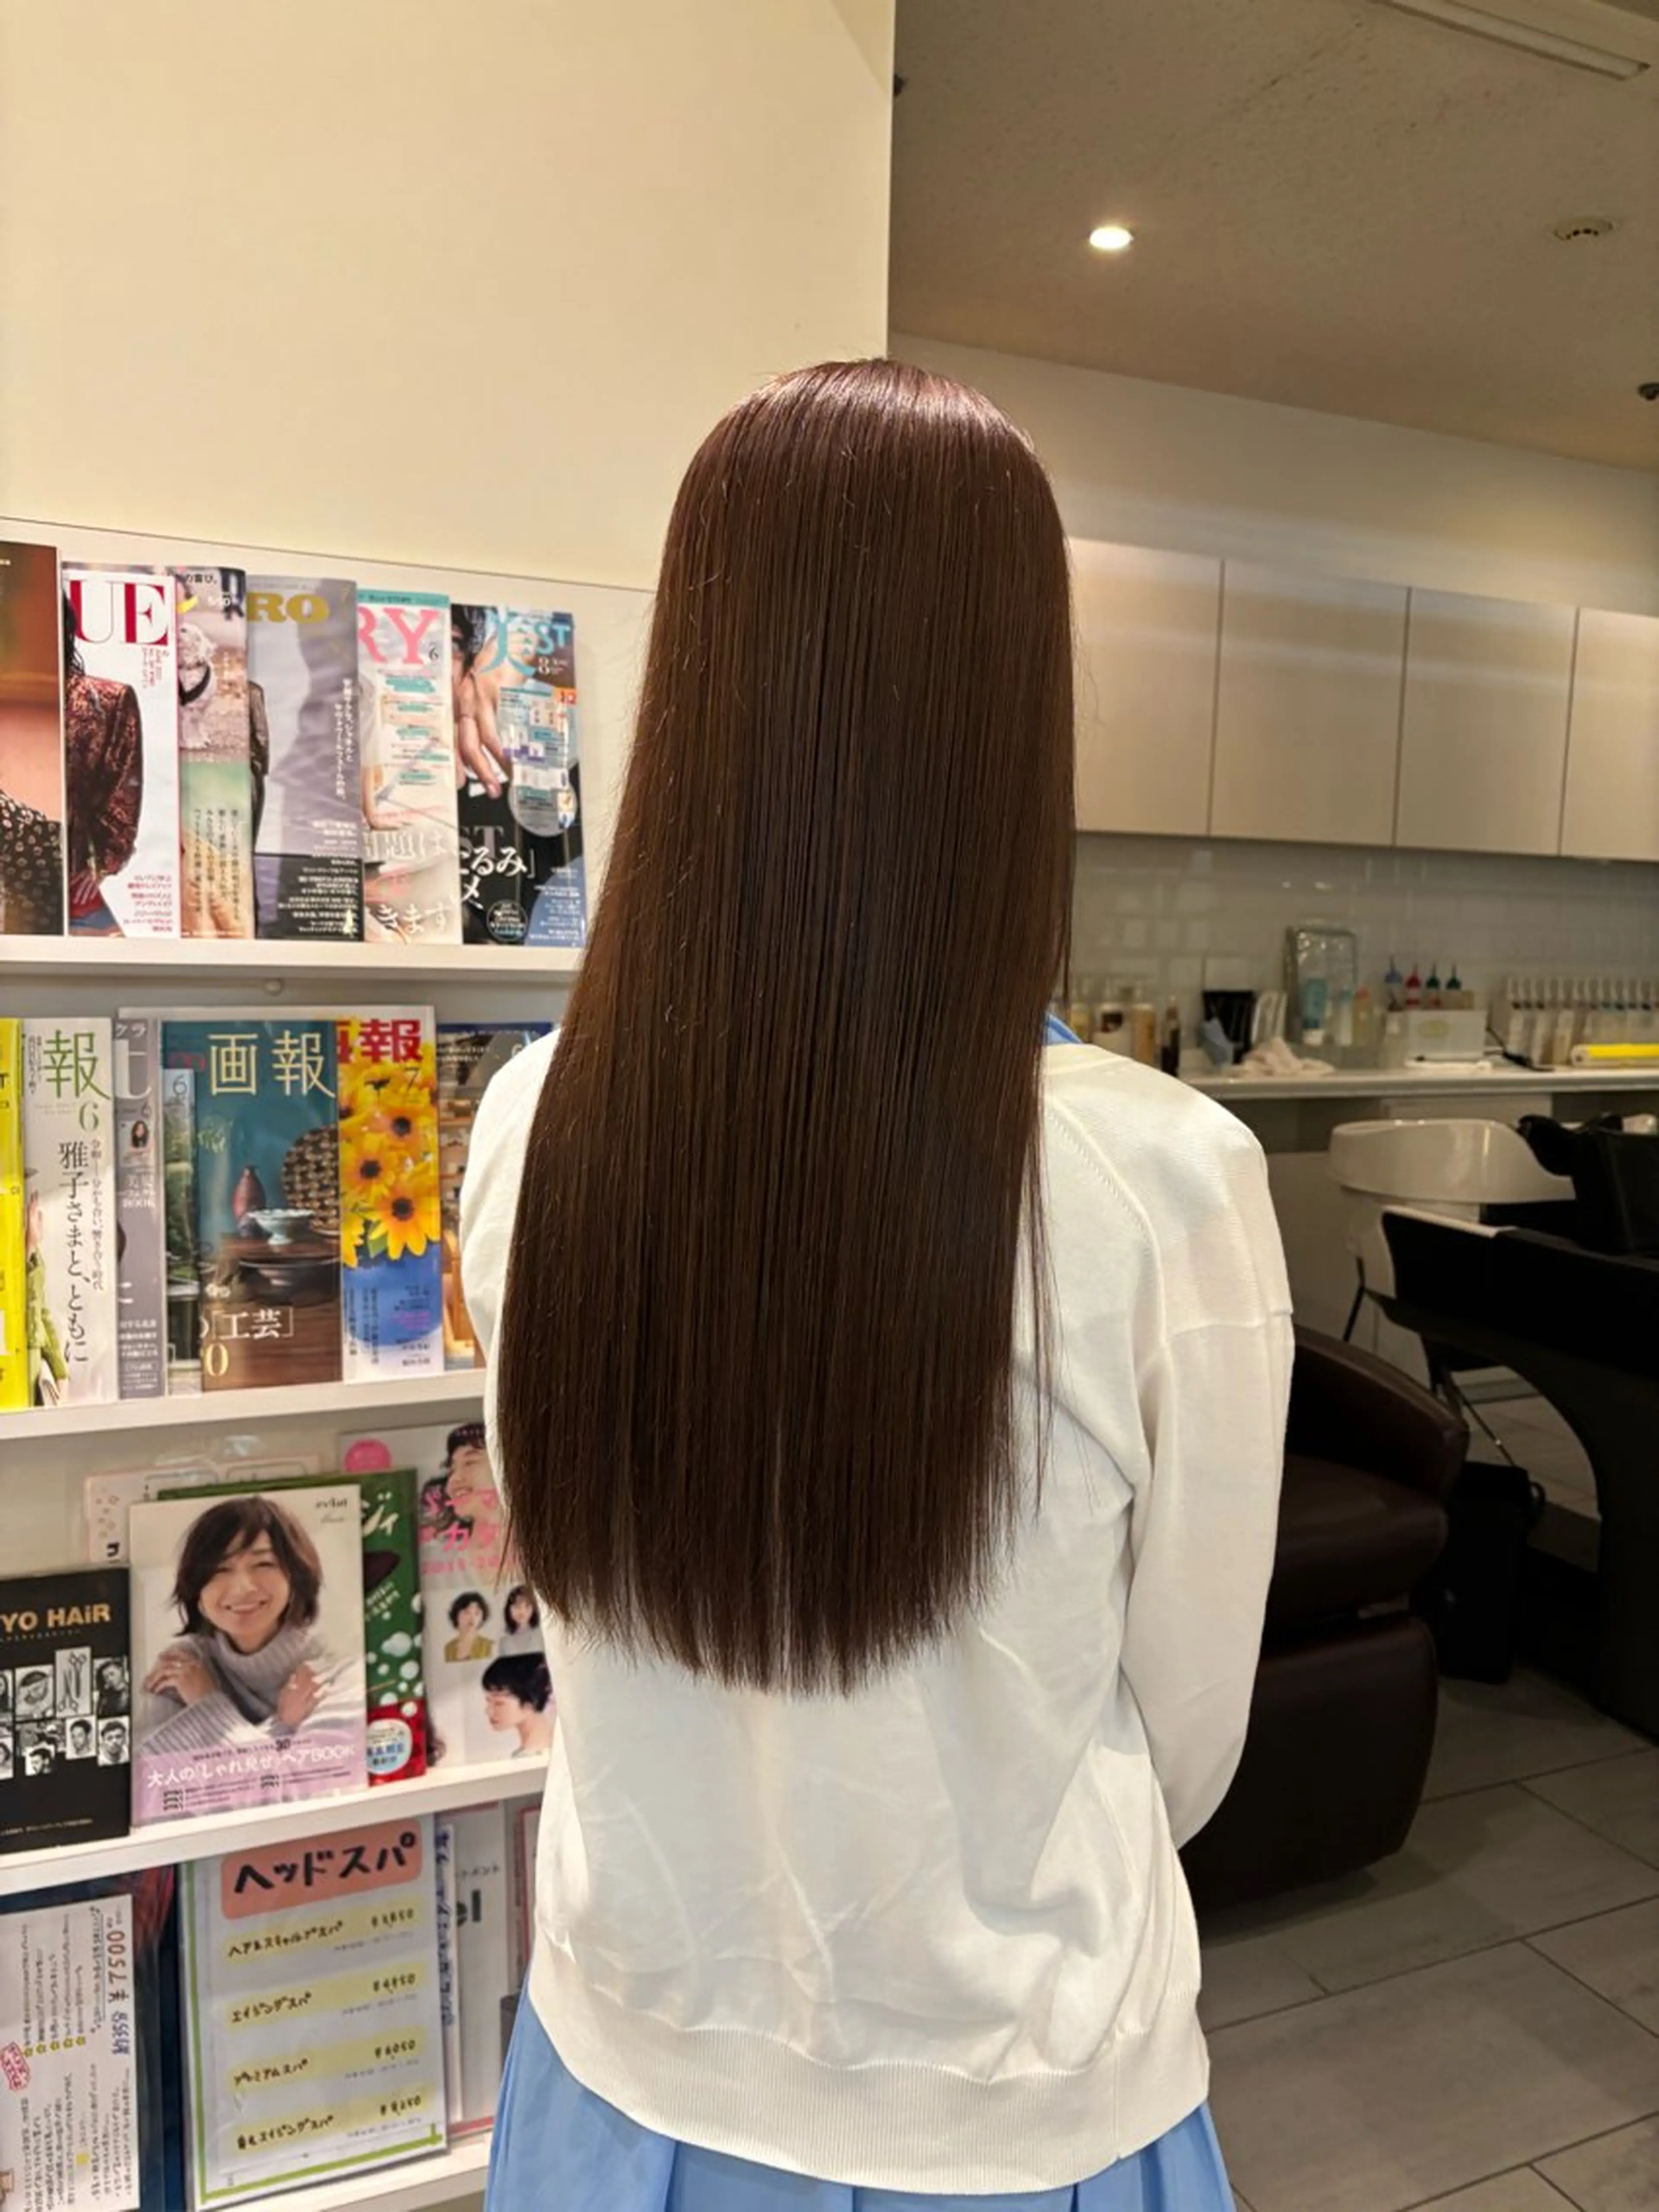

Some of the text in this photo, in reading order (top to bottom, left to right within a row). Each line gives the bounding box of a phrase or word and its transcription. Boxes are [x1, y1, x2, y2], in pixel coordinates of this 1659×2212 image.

[69, 579, 168, 646] UE
[245, 592, 330, 624] RO
[43, 1029, 112, 1100] 報
[207, 1030, 336, 1099] 画報
[79, 1101, 99, 1131] 6
[0, 1611, 38, 1634] YO
[234, 1831, 417, 1894] ヘッドスパ
